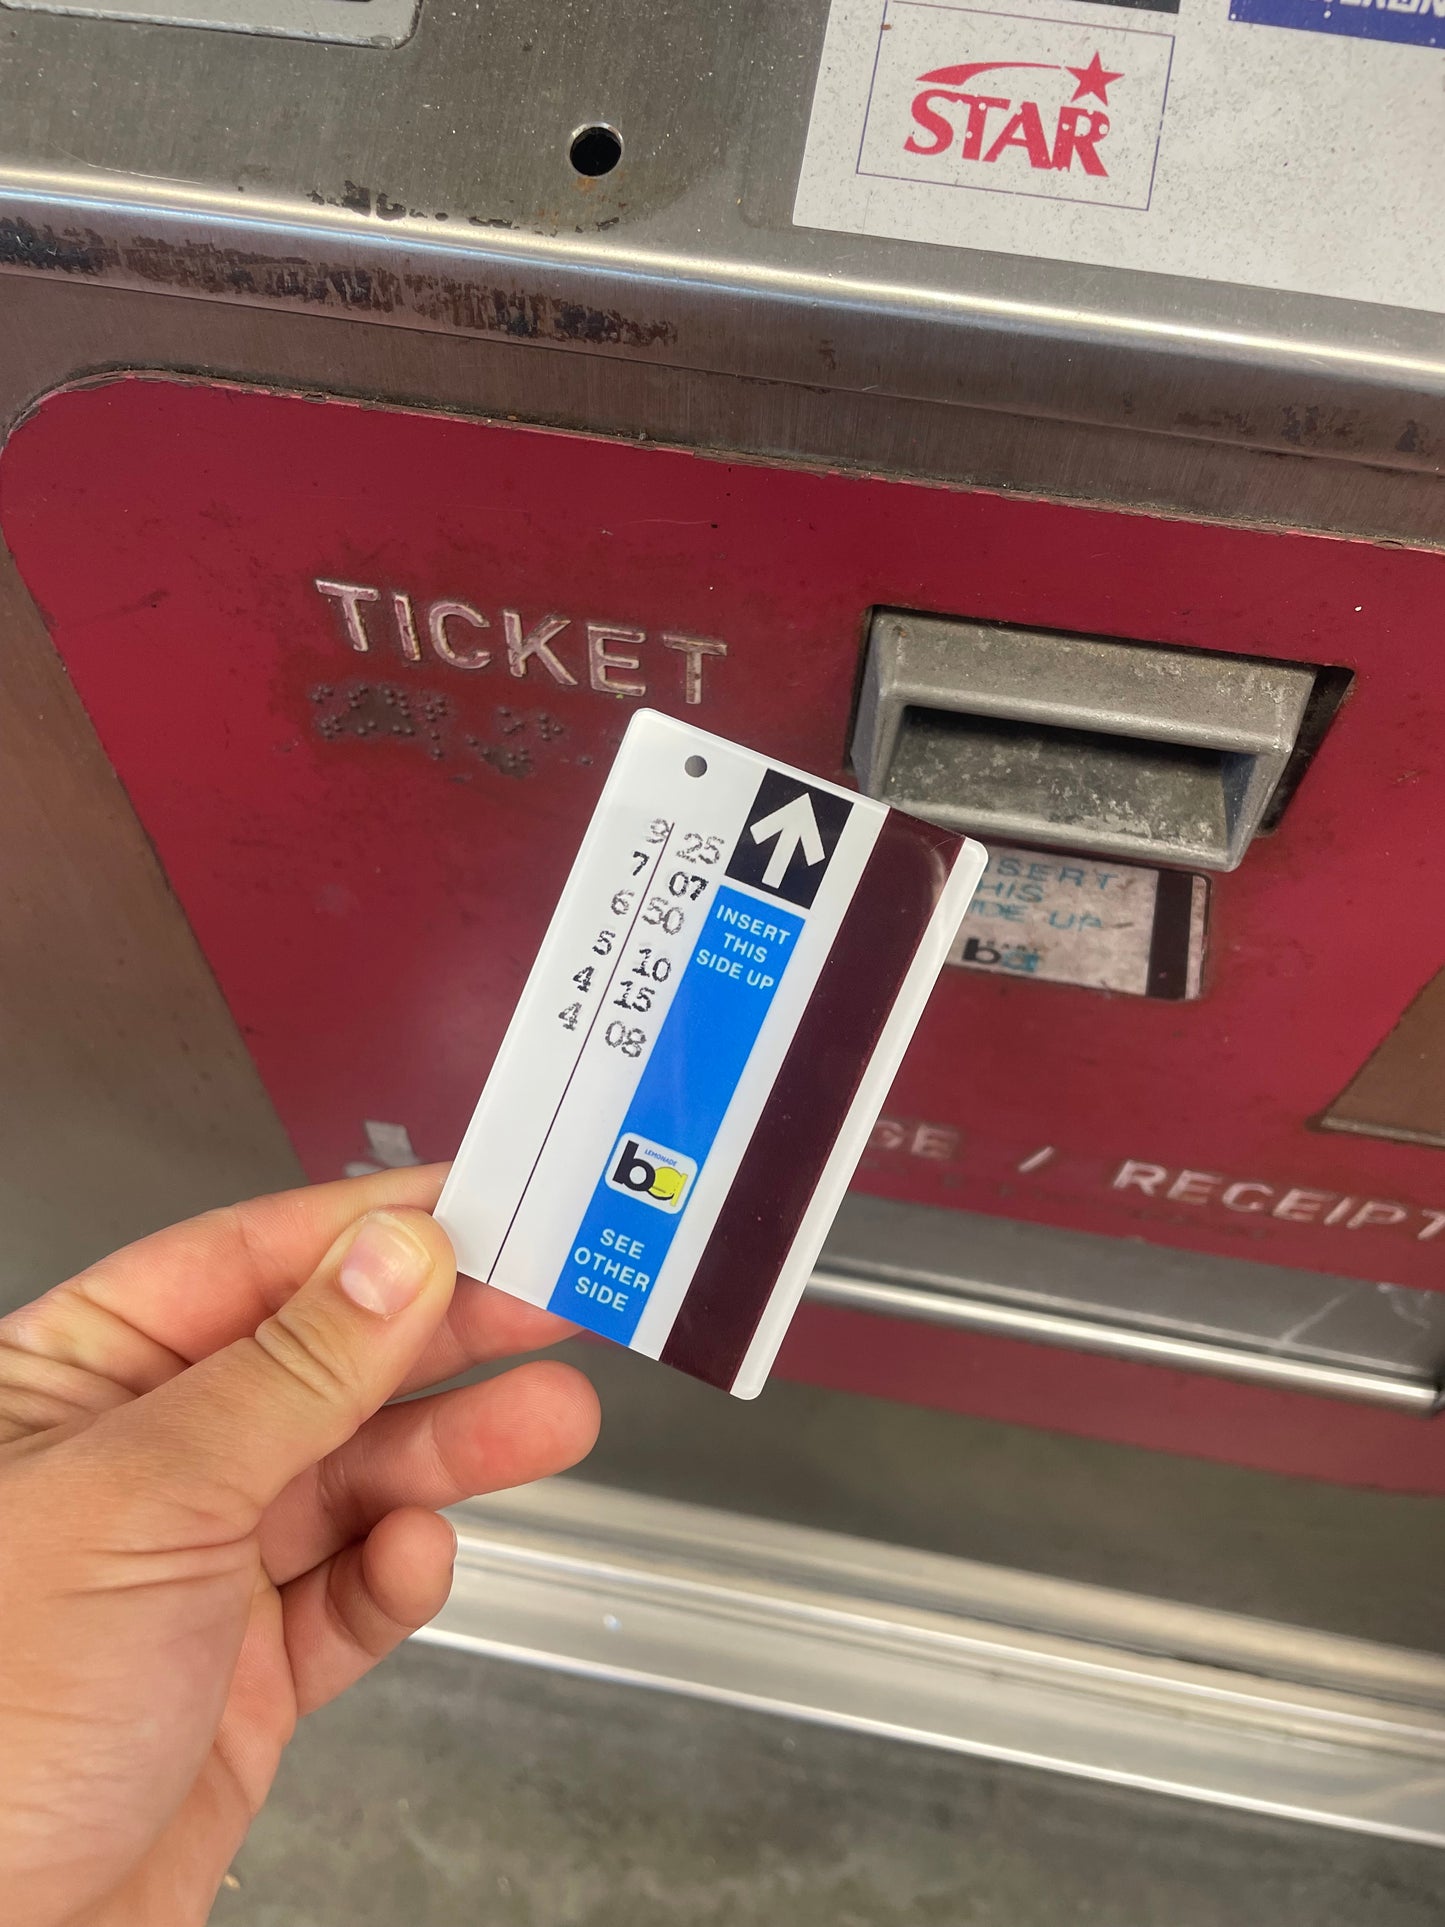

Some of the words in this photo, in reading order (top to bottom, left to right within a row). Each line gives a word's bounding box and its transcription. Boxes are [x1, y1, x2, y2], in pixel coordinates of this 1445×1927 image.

[903, 88, 1111, 178] STAR
[315, 579, 728, 704] TICKET
[646, 818, 670, 844] 9
[676, 833, 724, 865] 25
[632, 851, 650, 876] 7
[668, 871, 709, 901] 07
[976, 879, 1043, 902] HIS
[983, 857, 1118, 890] SERT
[610, 889, 635, 916] 6
[641, 897, 685, 935] 50
[716, 904, 791, 945] INSERT
[592, 930, 616, 956] 5
[632, 948, 671, 982] 10
[696, 949, 743, 980] SIDE
[746, 969, 774, 990] UP
[723, 932, 768, 963] THIS
[572, 966, 595, 992] 4
[613, 980, 655, 1013] 15
[558, 1002, 582, 1031] 4
[604, 1020, 647, 1058] 08
[644, 1149, 677, 1167] LEMONADE
[1113, 1160, 1445, 1240] RECEIPT
[599, 1228, 645, 1260] SEE
[574, 1247, 650, 1292] OTHER
[575, 1277, 629, 1312] SIDE
